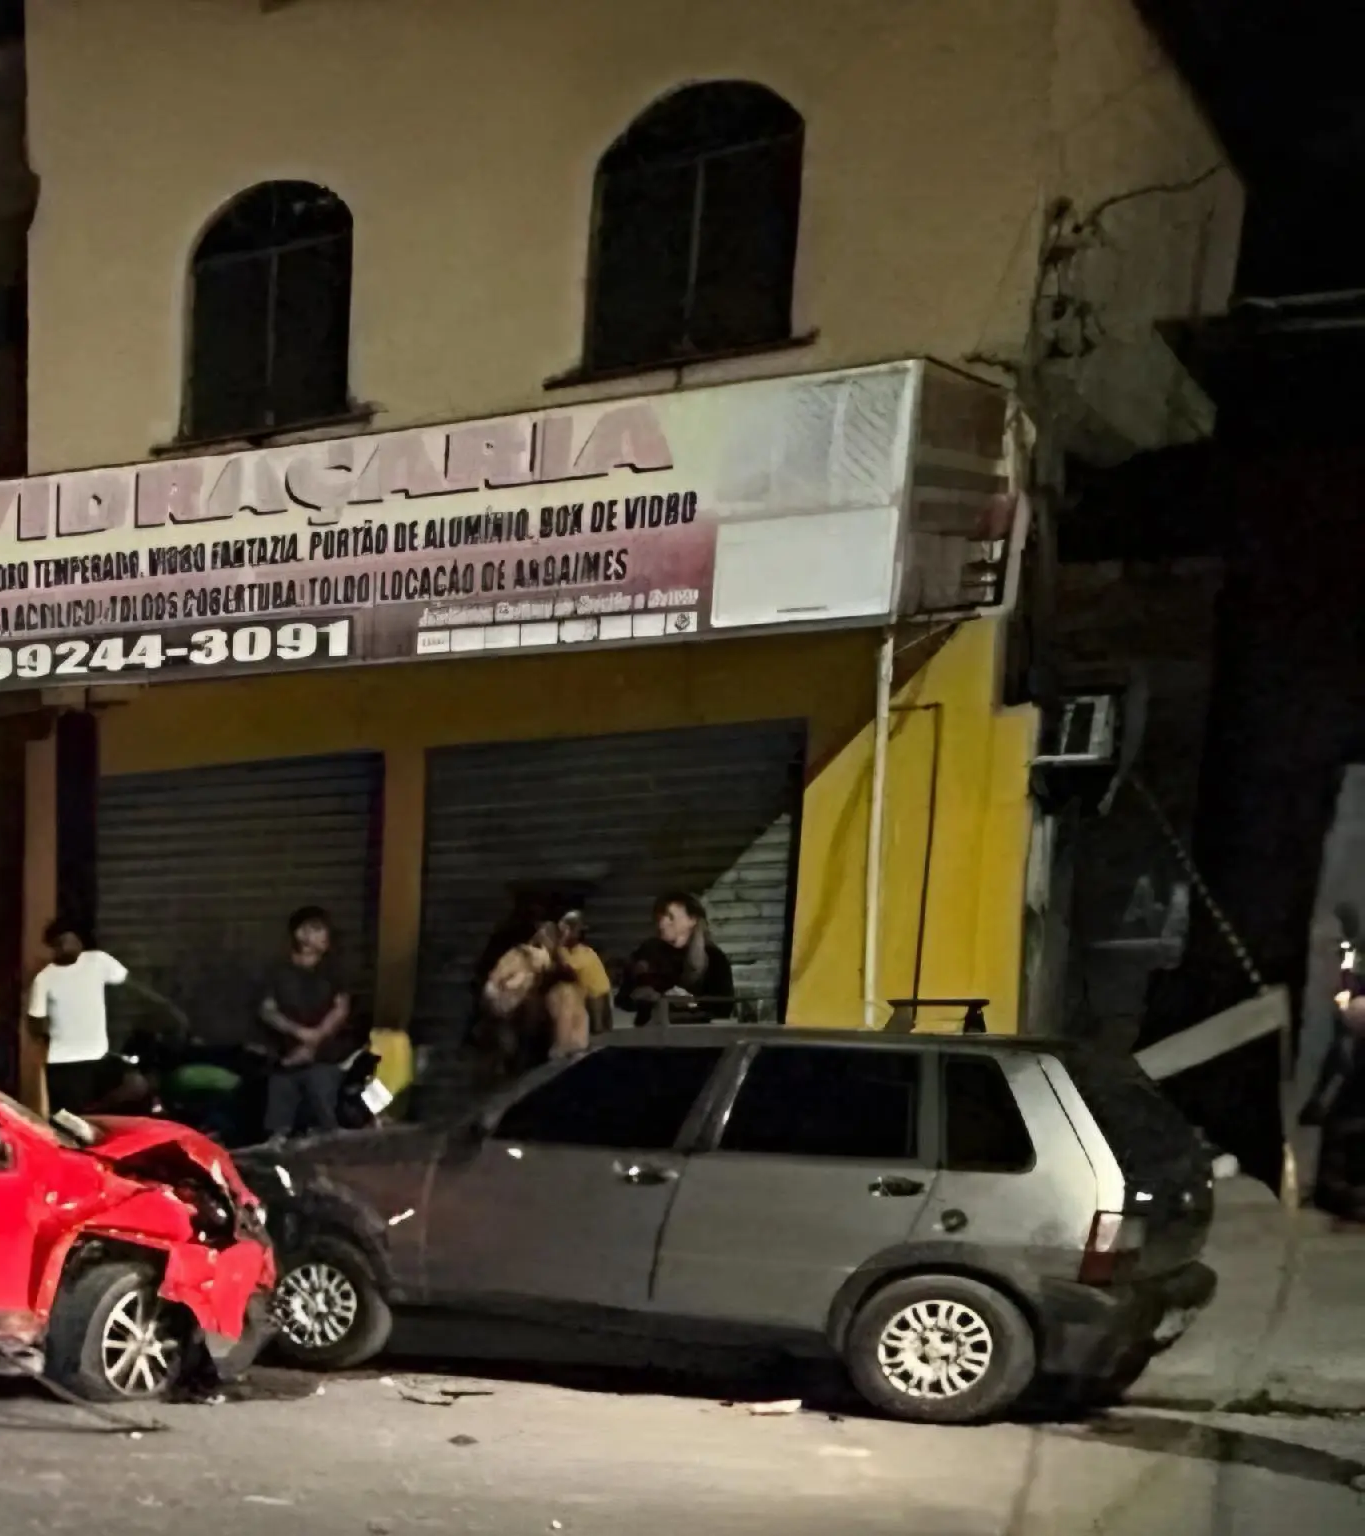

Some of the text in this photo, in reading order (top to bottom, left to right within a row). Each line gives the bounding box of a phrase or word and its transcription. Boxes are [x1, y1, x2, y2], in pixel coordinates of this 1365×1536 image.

[309, 519, 387, 561] PORTÃO
[394, 520, 419, 554] DE
[539, 503, 583, 539] BOX
[591, 498, 618, 534] DE
[624, 490, 699, 531] VIDRO
[481, 559, 506, 593] DE
[513, 548, 630, 589] ANDAIMES
